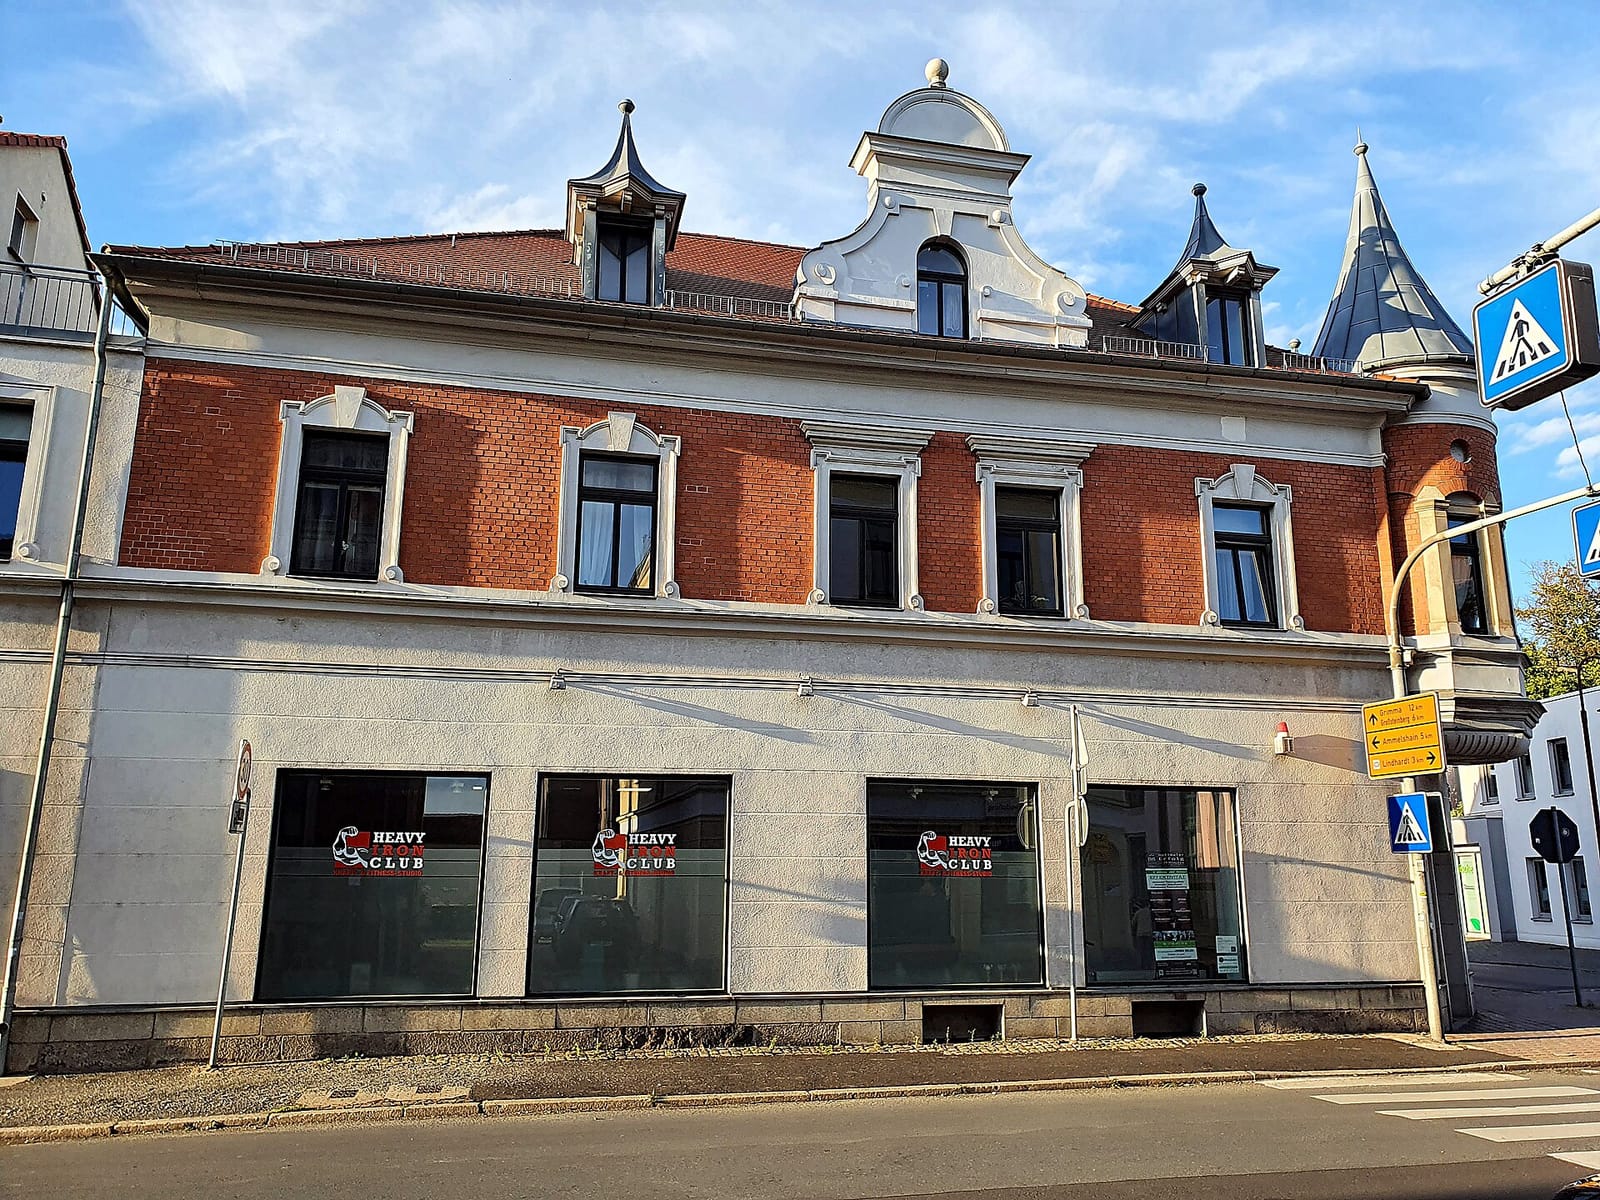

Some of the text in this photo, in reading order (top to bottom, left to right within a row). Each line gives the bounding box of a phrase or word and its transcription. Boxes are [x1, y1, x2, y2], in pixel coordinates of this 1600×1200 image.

[1380, 707, 1402, 716] Grimma
[1408, 703, 1415, 712] 12
[1411, 713, 1416, 721] 6
[1383, 734, 1419, 745] Ammelshain
[1420, 731, 1425, 740] 5
[1382, 758, 1410, 767] Lindhardt
[1411, 756, 1416, 764] 3
[372, 831, 426, 844] HEAVY
[628, 833, 677, 845] HEAVY
[948, 836, 992, 847] HEAVY
[371, 844, 425, 856] IRON
[628, 846, 676, 857] IRON
[949, 848, 992, 859] IRON
[369, 857, 424, 869] CLUB
[626, 858, 676, 869] CLUB
[948, 859, 993, 870] CLUB
